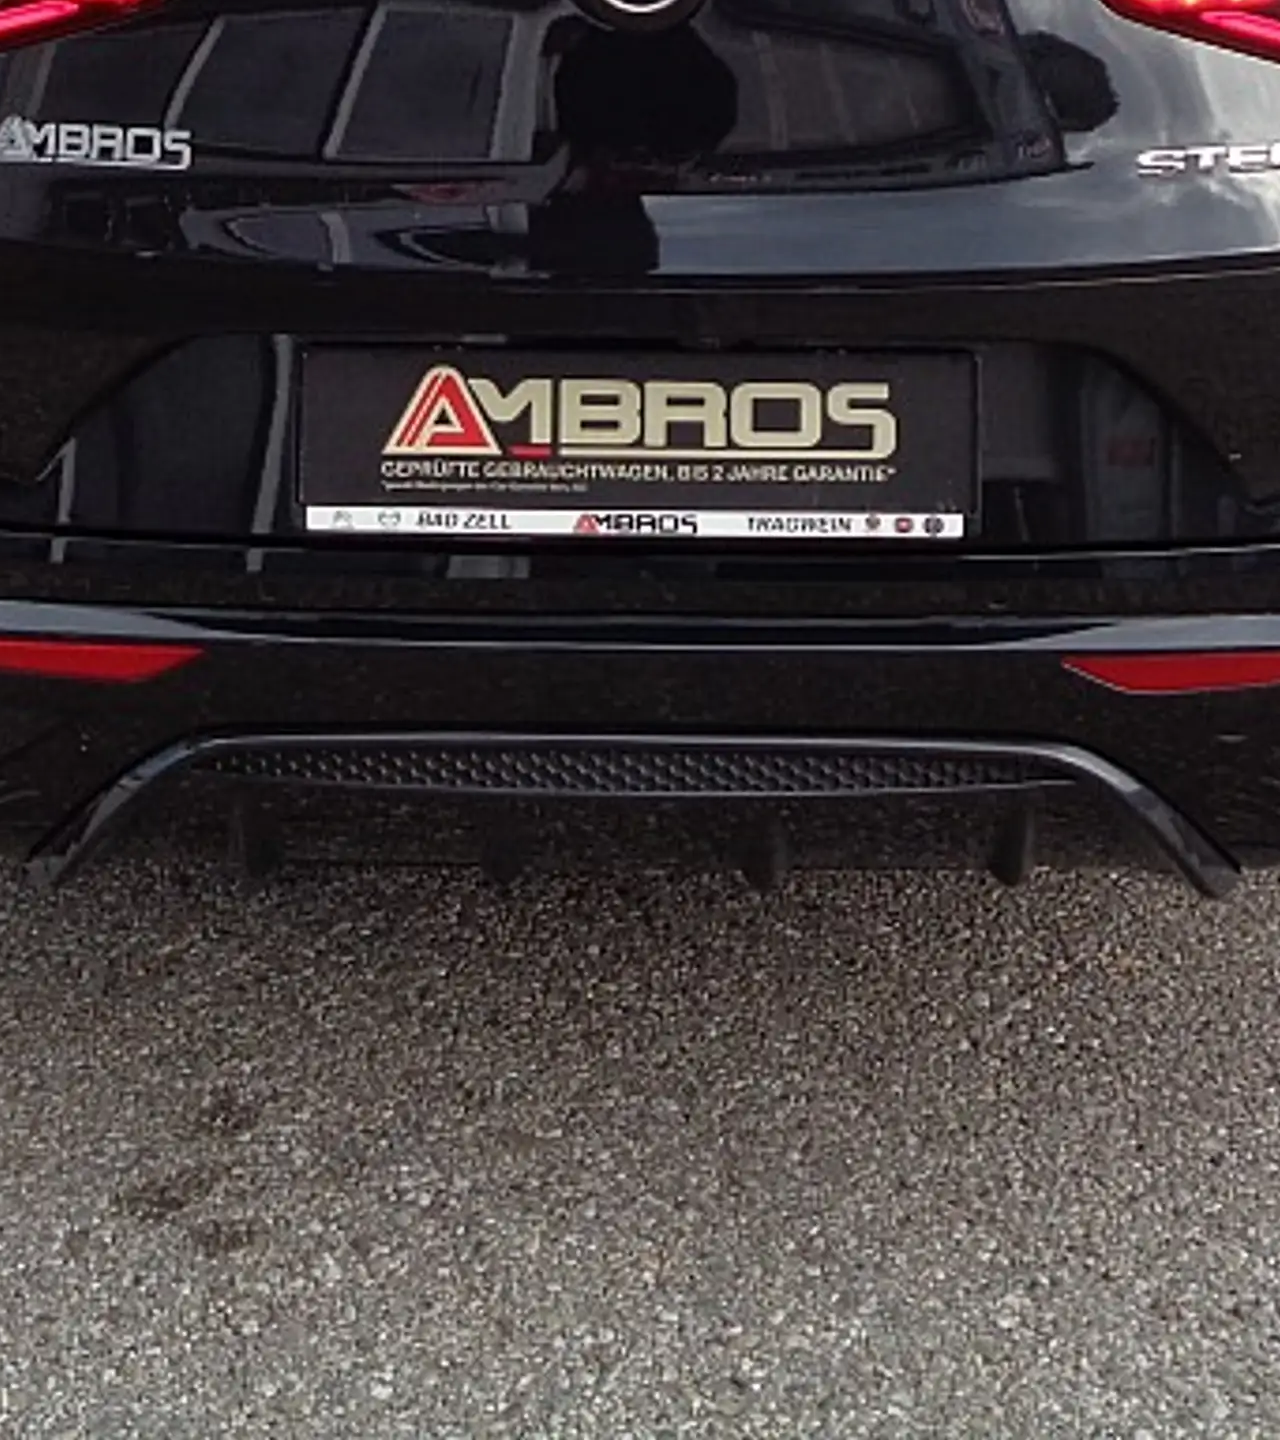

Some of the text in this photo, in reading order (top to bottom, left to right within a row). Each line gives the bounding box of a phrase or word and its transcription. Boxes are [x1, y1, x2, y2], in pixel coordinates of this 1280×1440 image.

[382, 366, 898, 460] AMBROS
[381, 459, 480, 478] GEPRÜFTE
[712, 464, 724, 481] 2
[727, 464, 789, 481] JAHRE
[417, 513, 457, 529] BAD
[463, 514, 511, 529] ZELL
[574, 513, 698, 535] AMBROS
